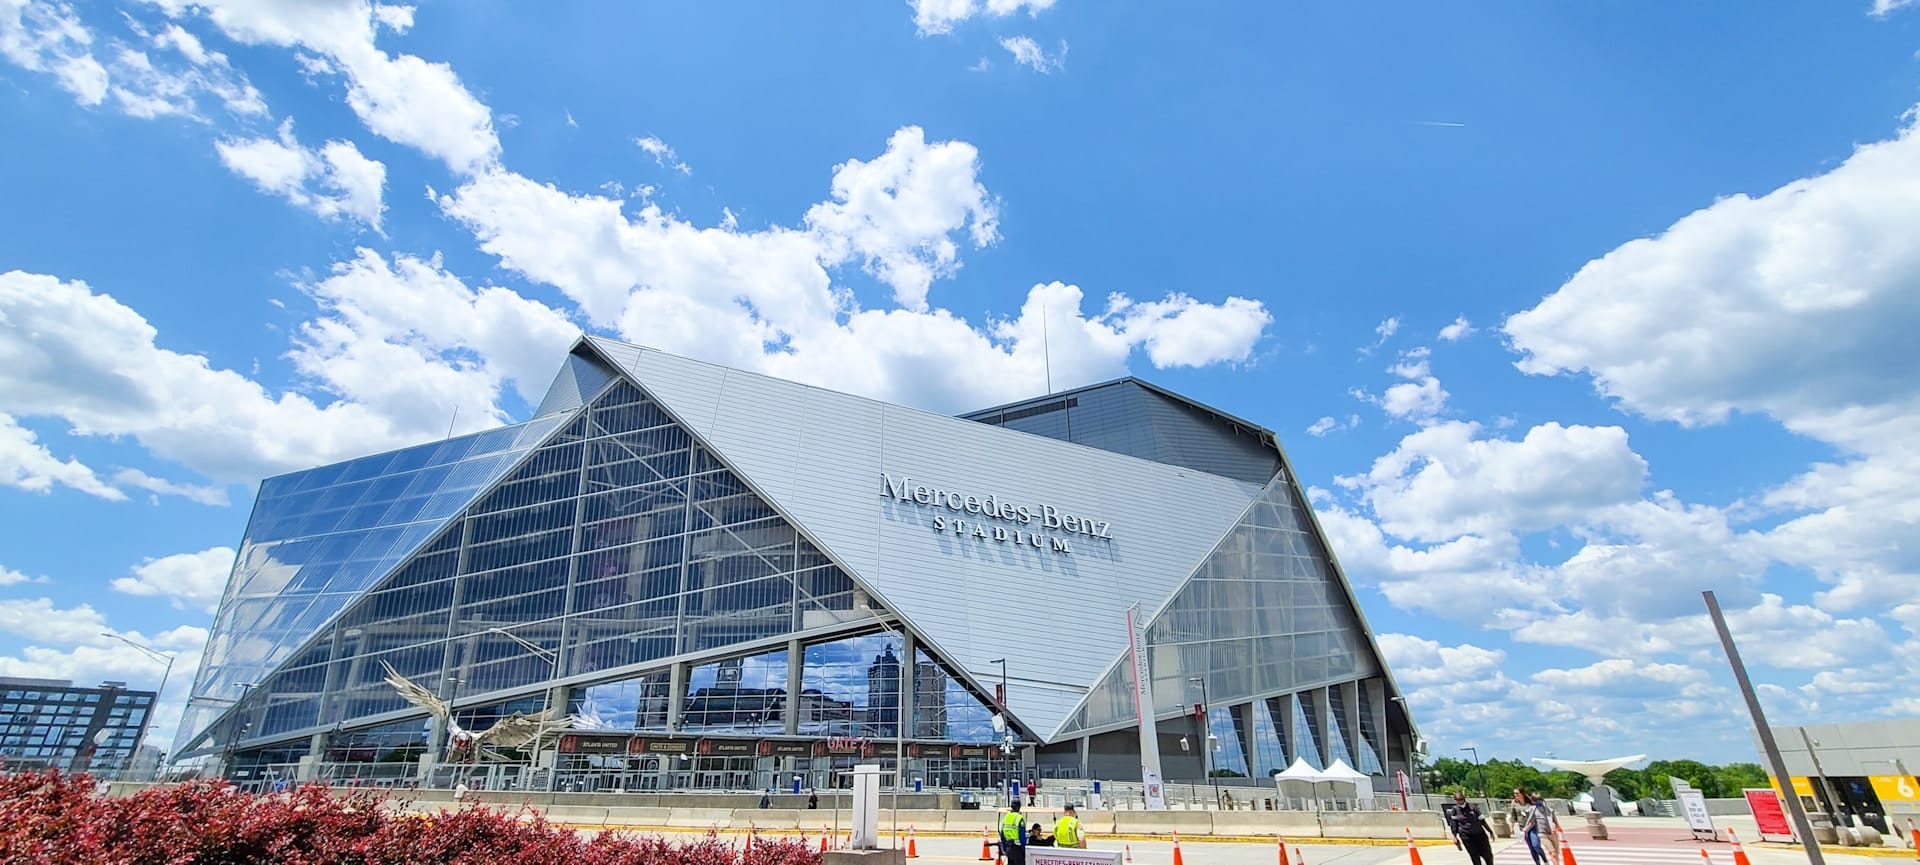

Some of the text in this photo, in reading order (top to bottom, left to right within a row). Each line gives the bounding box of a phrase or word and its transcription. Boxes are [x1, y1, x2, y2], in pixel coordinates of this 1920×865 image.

[879, 472, 1113, 540] Mercedes-Benz
[932, 515, 1071, 553] STADIUM
[827, 736, 857, 750] GATE
[1897, 776, 1914, 798] 6
